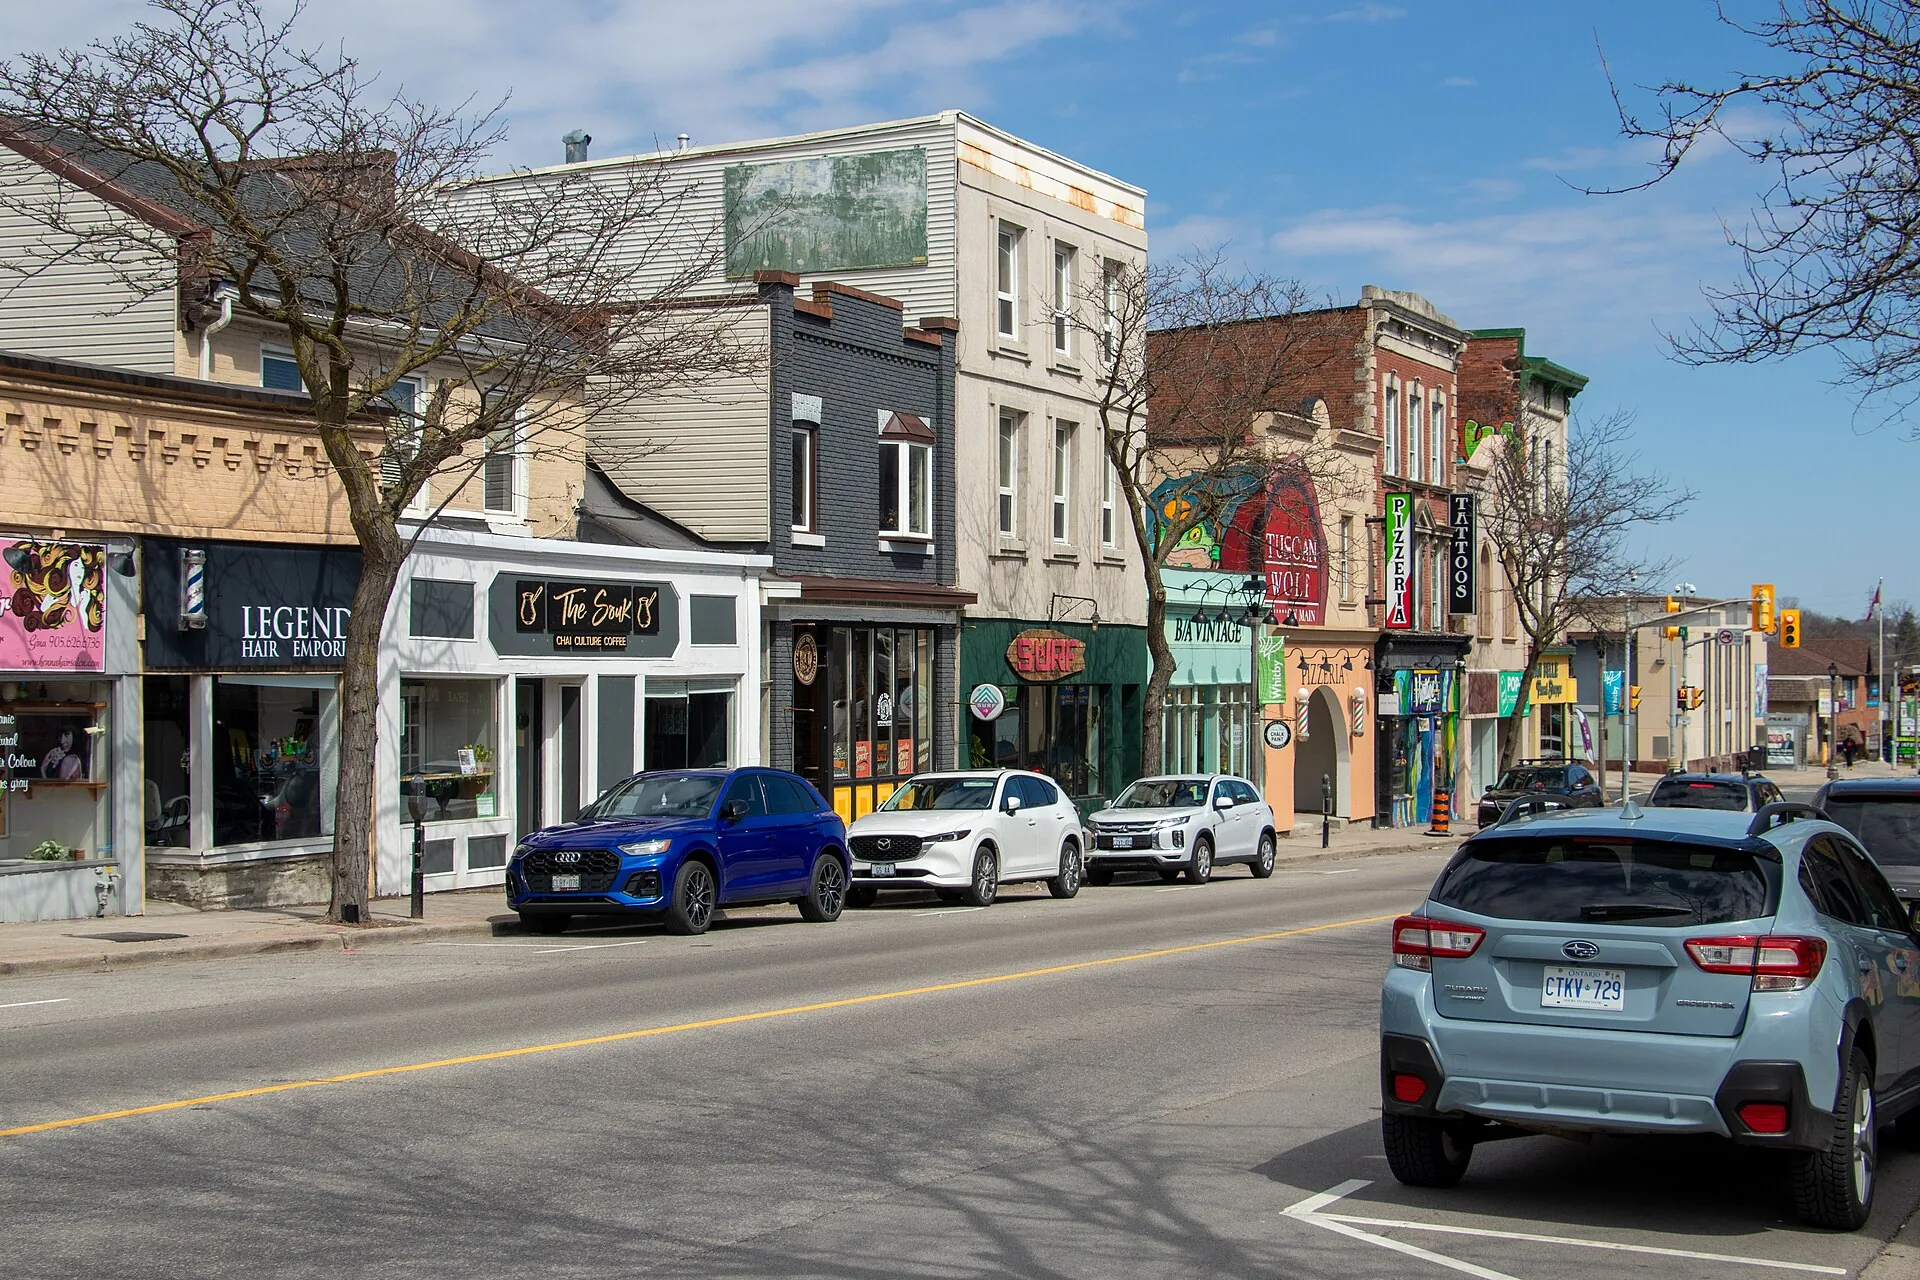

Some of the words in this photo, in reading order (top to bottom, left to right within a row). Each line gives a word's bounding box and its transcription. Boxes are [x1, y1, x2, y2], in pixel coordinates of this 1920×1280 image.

[1266, 533, 1317, 562] TUSCAN
[1393, 497, 1407, 623] PIZZERIA
[1455, 497, 1469, 598] TATTOOS
[1271, 571, 1311, 598] WOLF
[553, 587, 588, 626] The
[591, 588, 632, 627] Souk
[1299, 608, 1316, 622] MAIN
[28, 635, 48, 650] Gina
[48, 635, 101, 649] 905.626.6736
[556, 635, 572, 646] CHAI
[574, 636, 602, 646] CULTURE
[603, 637, 627, 647] COFFEE
[1195, 618, 1242, 643] VINTAGE
[241, 640, 279, 658] HAIR
[1017, 637, 1078, 672] SURF
[1272, 660, 1284, 699] Whitby
[1301, 663, 1345, 685] PIZZERIA
[1611, 685, 1620, 711] Whitby
[8, 753, 37, 769] Colour
[10, 779, 29, 792] gray
[1568, 969, 1601, 978] ONTARIO
[1444, 984, 1488, 993] SUBARU
[1545, 976, 1583, 998] CTKV
[1593, 979, 1621, 1001] 729
